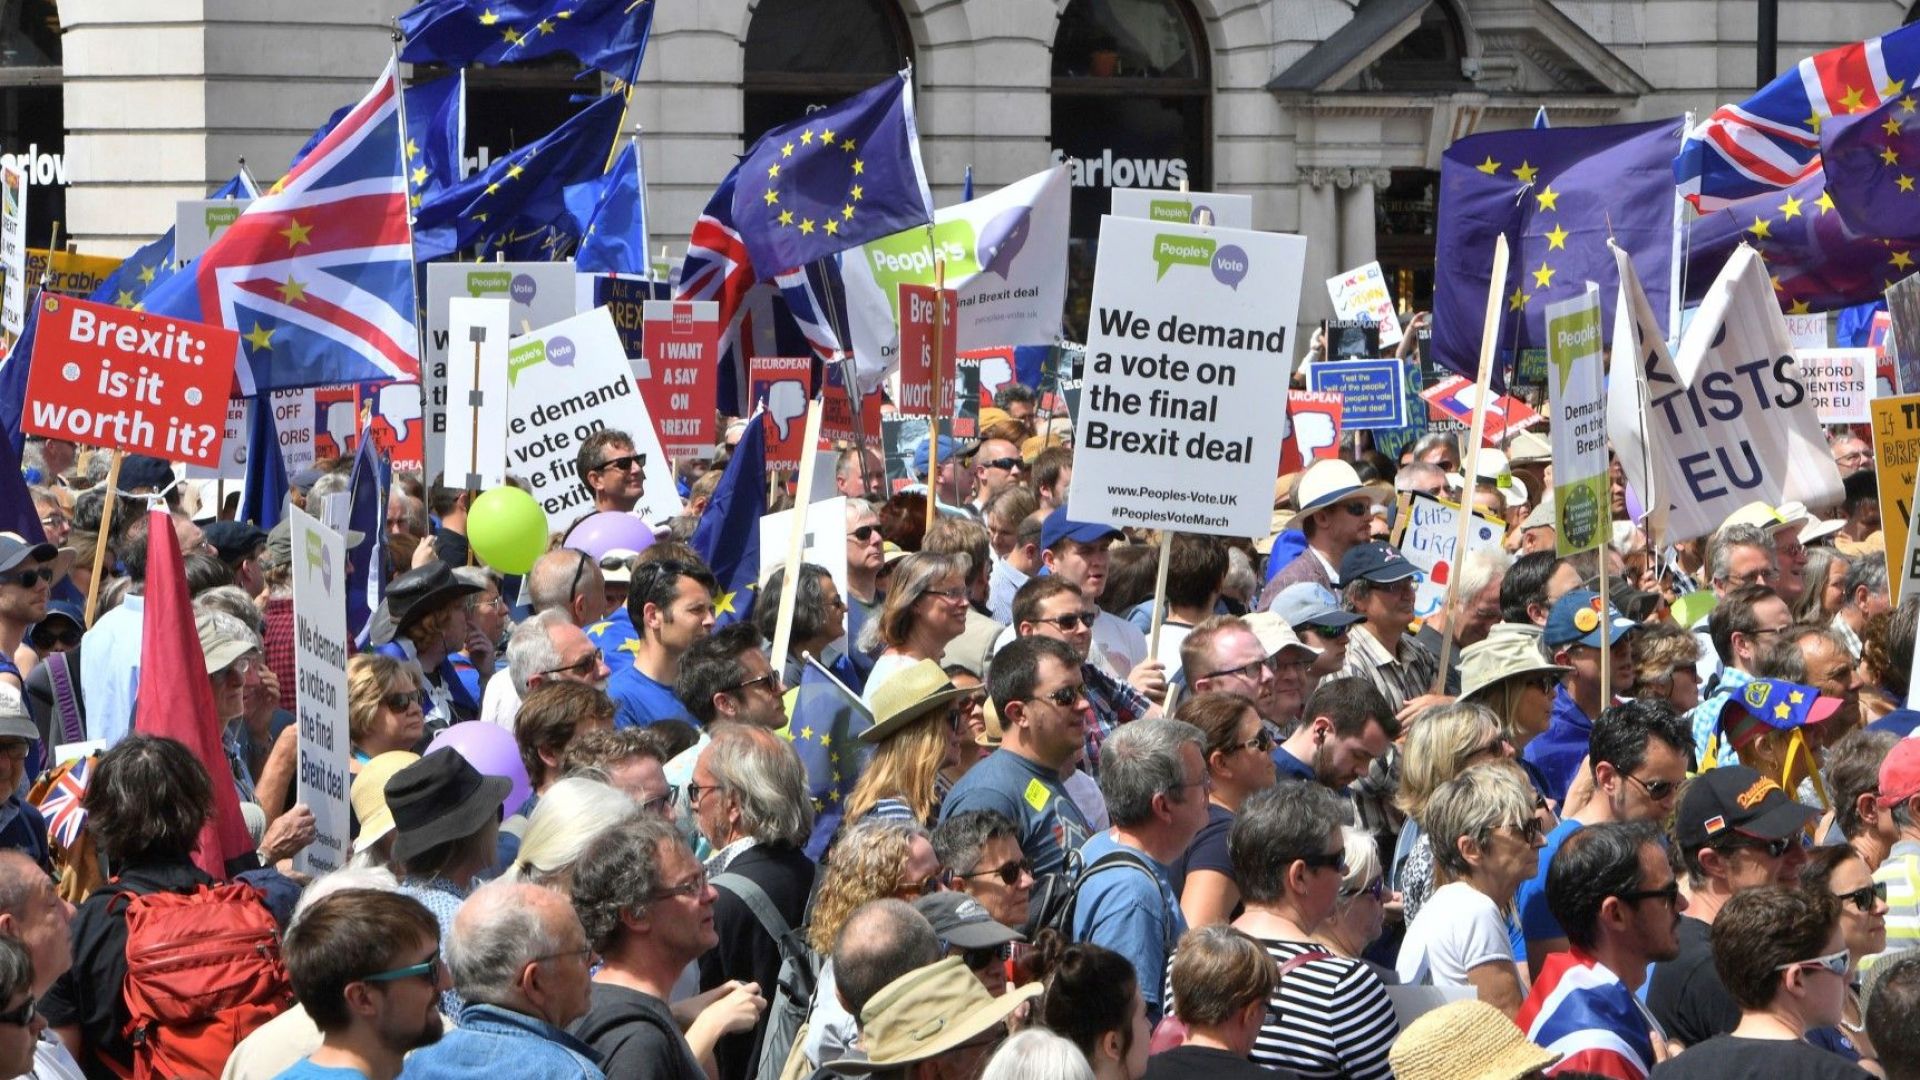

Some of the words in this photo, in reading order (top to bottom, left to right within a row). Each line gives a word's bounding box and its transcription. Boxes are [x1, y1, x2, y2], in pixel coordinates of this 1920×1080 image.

[1154, 207, 1189, 217] People's
[1160, 242, 1209, 259] People's
[1217, 258, 1244, 273] Vote
[471, 278, 508, 289] People's
[513, 284, 533, 294] Vote
[957, 295, 976, 307] inal
[979, 291, 1010, 304] Brexit
[1014, 287, 1039, 298] deal
[607, 300, 643, 330] REX
[910, 293, 950, 327] Bret:
[69, 309, 206, 366] Brexit:
[1100, 308, 1150, 340] We
[1157, 315, 1286, 353] demand
[1558, 322, 1600, 349] People's
[1786, 319, 1825, 336] REXIT
[433, 330, 449, 350] W
[660, 342, 665, 360] I
[667, 342, 703, 360] WANT
[921, 335, 930, 368] is
[510, 348, 541, 364] eople's
[550, 343, 572, 359] Vote
[761, 358, 810, 370] EUROPEAN
[956, 358, 979, 368] PEAN
[664, 368, 672, 385] A
[674, 368, 698, 385] SAY
[1094, 352, 1112, 375] a
[1121, 354, 1189, 382] vote
[1196, 362, 1236, 386] on
[98, 359, 128, 398] is
[135, 366, 164, 406] it
[903, 379, 931, 408] wort
[1806, 382, 1864, 393] IENTISTS
[506, 416, 526, 438] e
[530, 374, 631, 427] demand
[670, 393, 689, 411] ON
[1090, 385, 1141, 415] the
[1150, 389, 1218, 422] final
[1289, 391, 1341, 403] UROPEAN
[1833, 397, 1851, 408] EU
[276, 404, 301, 420] OFF
[1565, 397, 1602, 421] Demand
[32, 400, 155, 448] worth
[165, 416, 216, 459] it?
[281, 428, 310, 446] ORIS
[514, 432, 570, 462] vote
[574, 418, 606, 441] on
[1574, 424, 1587, 437] on
[1085, 421, 1179, 456] Brexit
[1186, 432, 1253, 464] deal
[1577, 432, 1604, 455] Brexit
[1883, 437, 1920, 468] BRE
[392, 460, 423, 470] OPEA
[549, 456, 580, 479] fin
[766, 461, 800, 471] ROPEA
[1678, 440, 1763, 503] EU
[1108, 485, 1238, 506] www.Peoples-Vote.UK
[1112, 507, 1229, 528] #PeoplesVoteMarch
[297, 614, 312, 652] We
[312, 625, 345, 671] demand
[299, 668, 304, 692] a
[306, 669, 325, 703] vote
[326, 679, 336, 711] on
[300, 706, 315, 743] the
[316, 712, 334, 752] final
[301, 749, 326, 796] Brexit
[326, 769, 344, 802] deal
